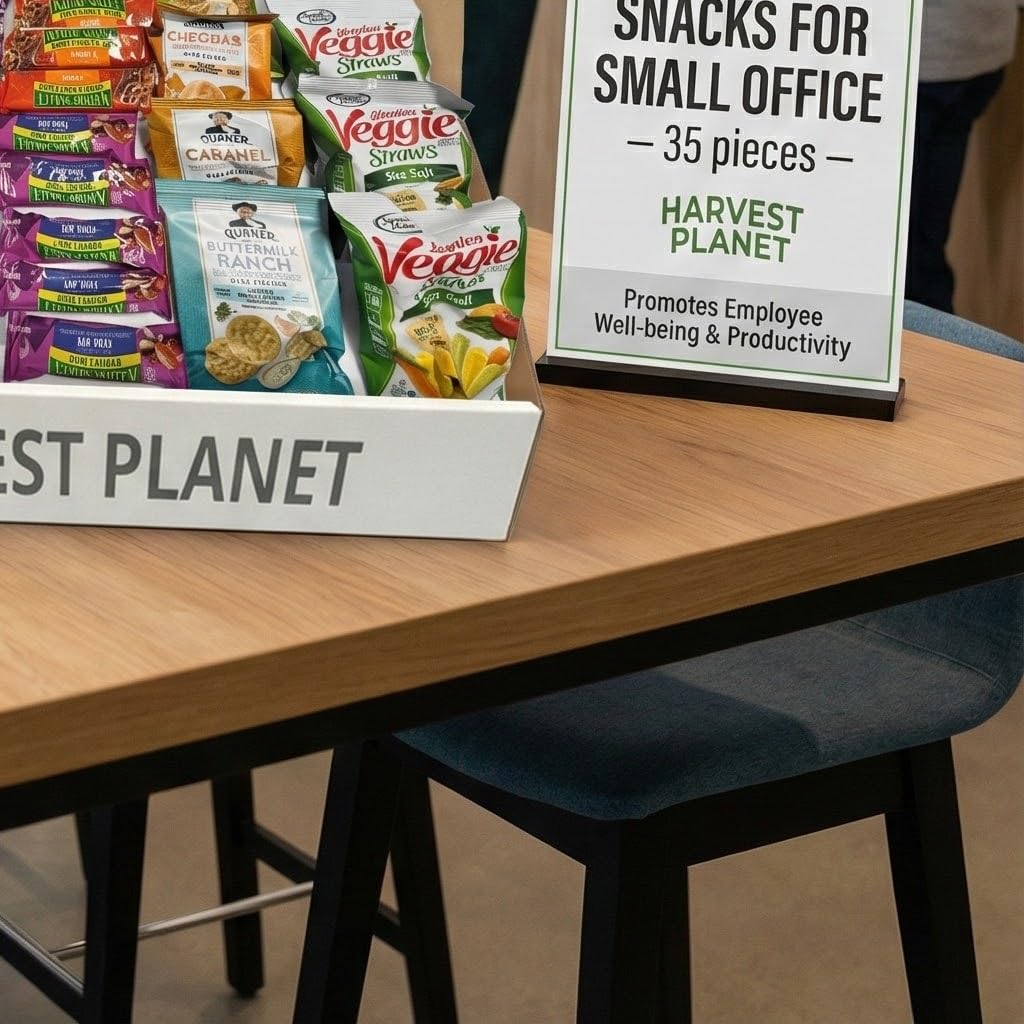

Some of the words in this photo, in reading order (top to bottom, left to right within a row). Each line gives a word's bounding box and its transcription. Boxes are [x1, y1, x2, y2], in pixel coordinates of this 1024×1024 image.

[295, 22, 413, 63] Veggie
[789, 2, 869, 57] FOR
[337, 55, 402, 75] Straws
[593, 53, 731, 113] SMALL
[742, 64, 884, 124] OFFICE
[326, 108, 460, 151] Veggie
[663, 124, 702, 164] 35
[711, 127, 816, 175] pieces
[369, 144, 438, 168] Straws
[661, 195, 804, 234] HARVEST
[207, 241, 298, 257] BUTTERMILK
[217, 254, 291, 272] RANCH
[670, 228, 791, 263] PLANET
[623, 288, 719, 318] Promotes
[724, 299, 823, 330] Employee
[594, 312, 700, 347] Well-being
[705, 327, 722, 344] &
[727, 327, 852, 363] Productivity
[103, 432, 365, 507] PLANET
